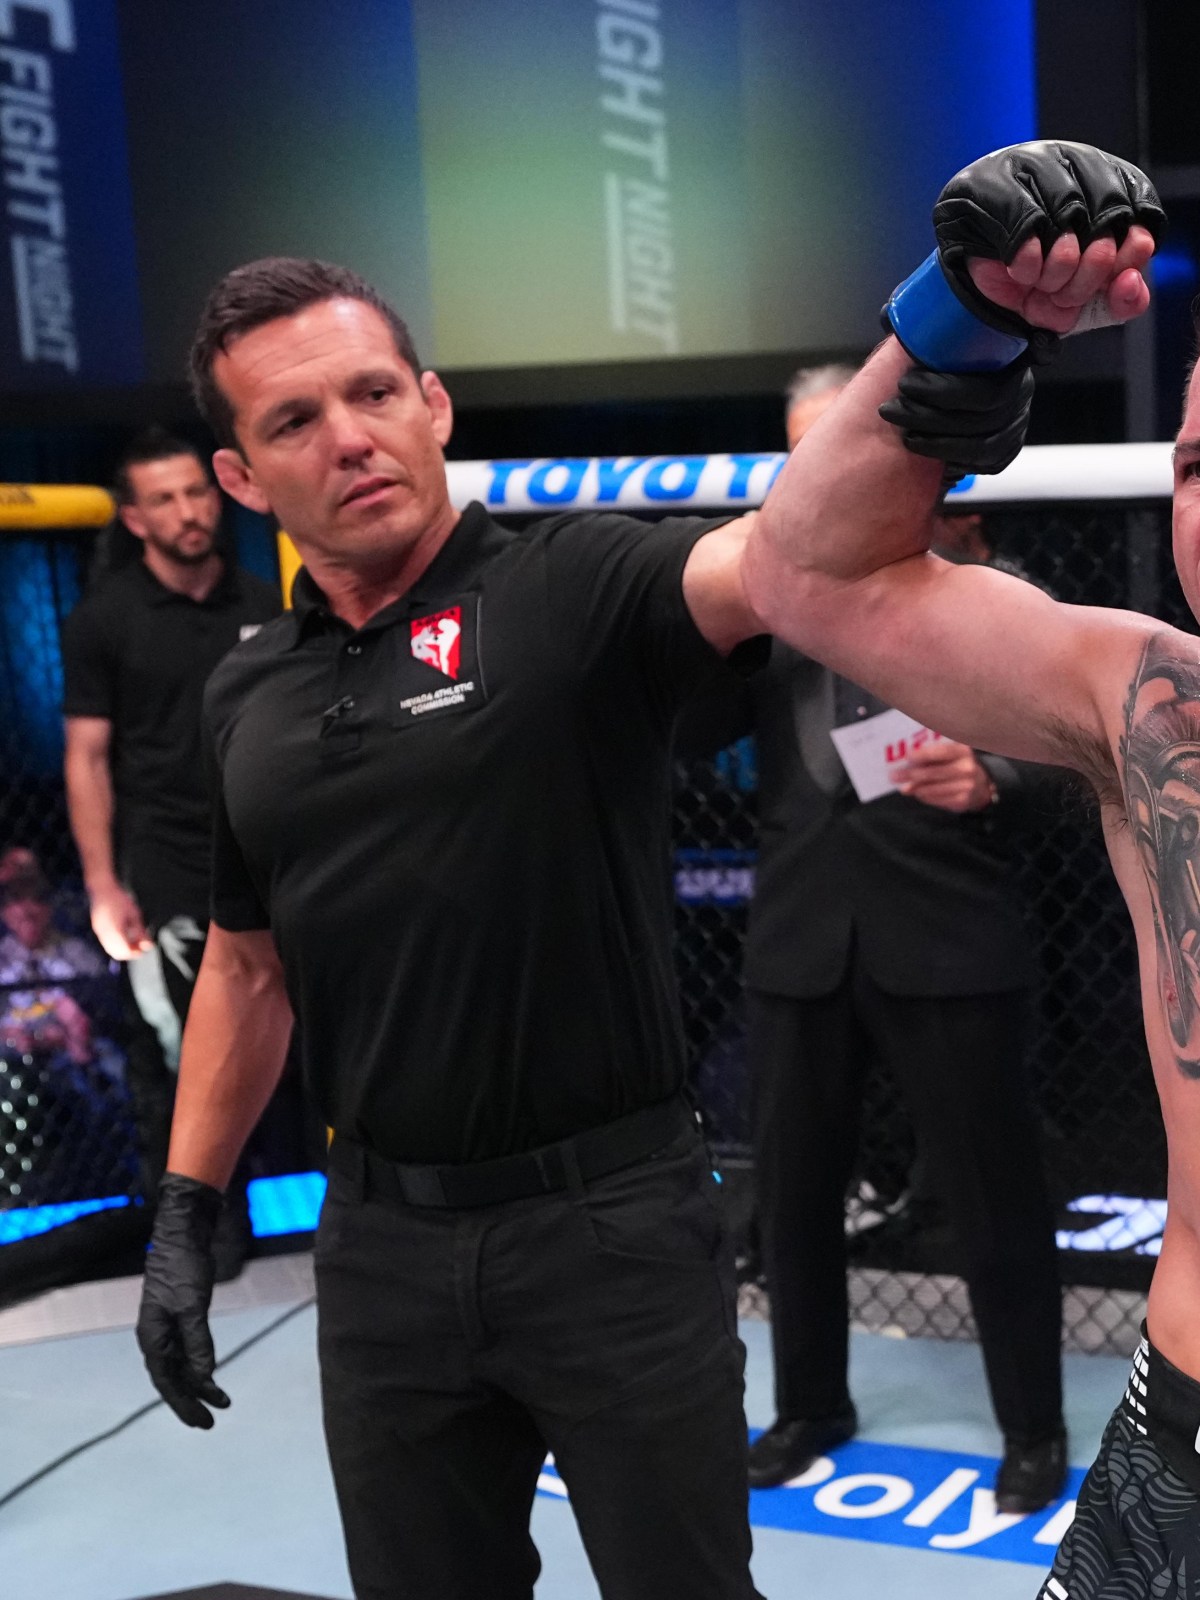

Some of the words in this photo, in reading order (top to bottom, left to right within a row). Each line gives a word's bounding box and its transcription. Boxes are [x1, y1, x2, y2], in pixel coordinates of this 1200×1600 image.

[0, 48, 67, 238] FIGHT
[28, 238, 81, 373] NIGHT
[622, 178, 680, 355] NIGHT
[486, 456, 708, 505] TOYO
[400, 692, 434, 710] NEVADA
[433, 681, 475, 699] ATHLETIC
[411, 693, 466, 716] COMMISSION
